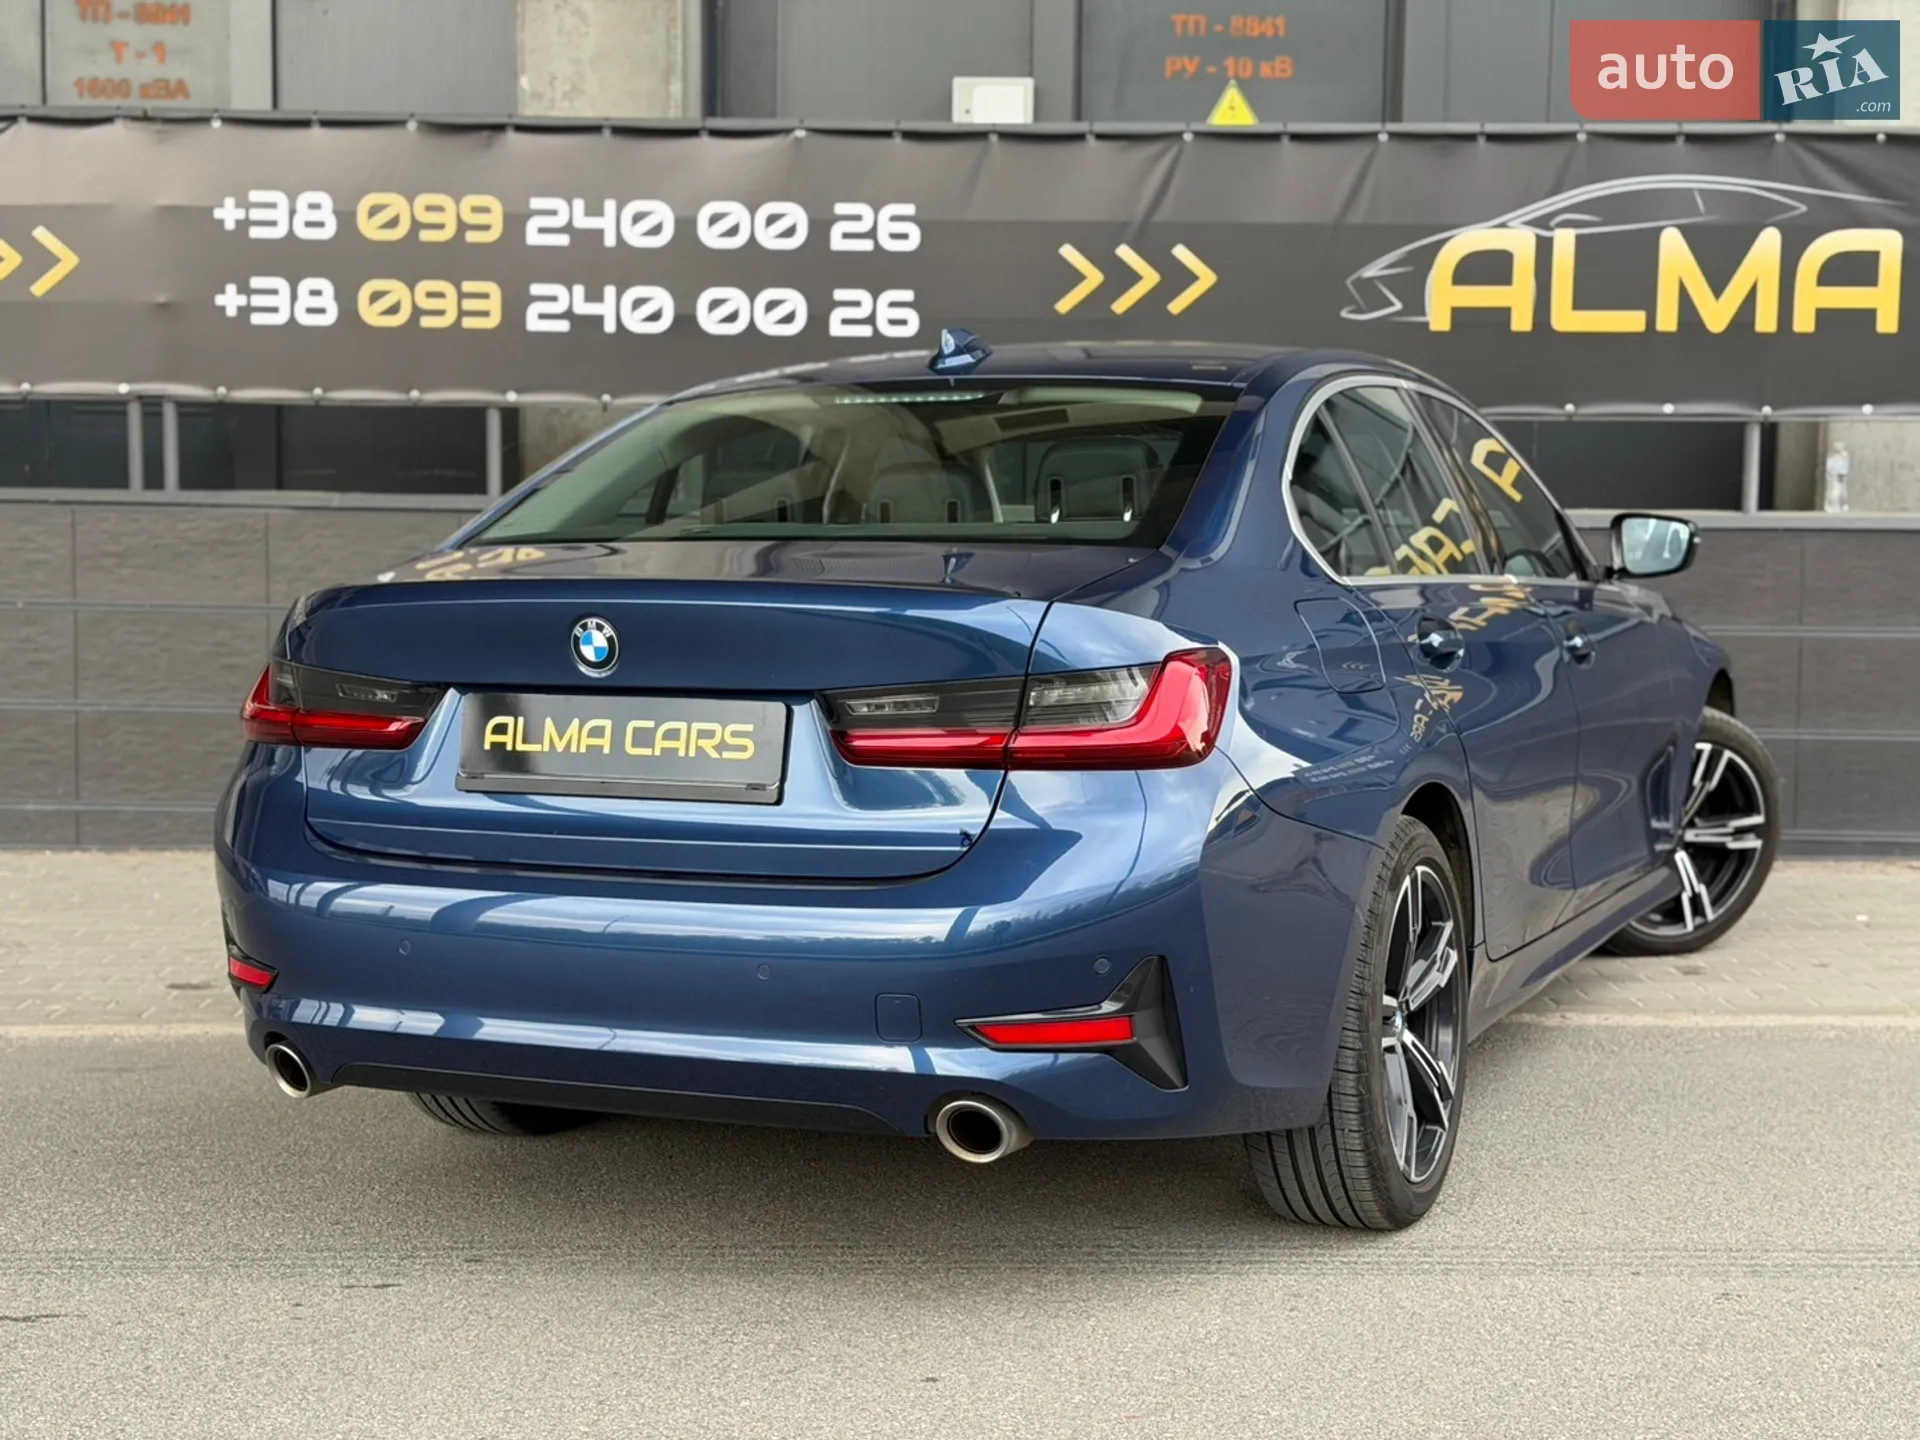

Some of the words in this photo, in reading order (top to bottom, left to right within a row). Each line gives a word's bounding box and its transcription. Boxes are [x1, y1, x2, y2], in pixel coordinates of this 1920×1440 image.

[1171, 13, 1207, 38] ТП
[1230, 14, 1287, 39] 8841
[1164, 56, 1201, 81] РУ
[1224, 56, 1255, 80] 10
[212, 190, 338, 241] +38
[355, 192, 504, 243] 099
[525, 196, 676, 249] 240
[696, 200, 809, 251] 00
[829, 202, 922, 252] 26
[1428, 225, 1903, 335] ALMA
[213, 276, 339, 327] +38
[356, 278, 503, 329] 093
[525, 282, 675, 334] 240
[695, 286, 808, 336] 00
[828, 288, 920, 338] 26
[573, 619, 613, 638] BMW
[483, 715, 613, 754] ALMA
[624, 719, 756, 760] CARS
